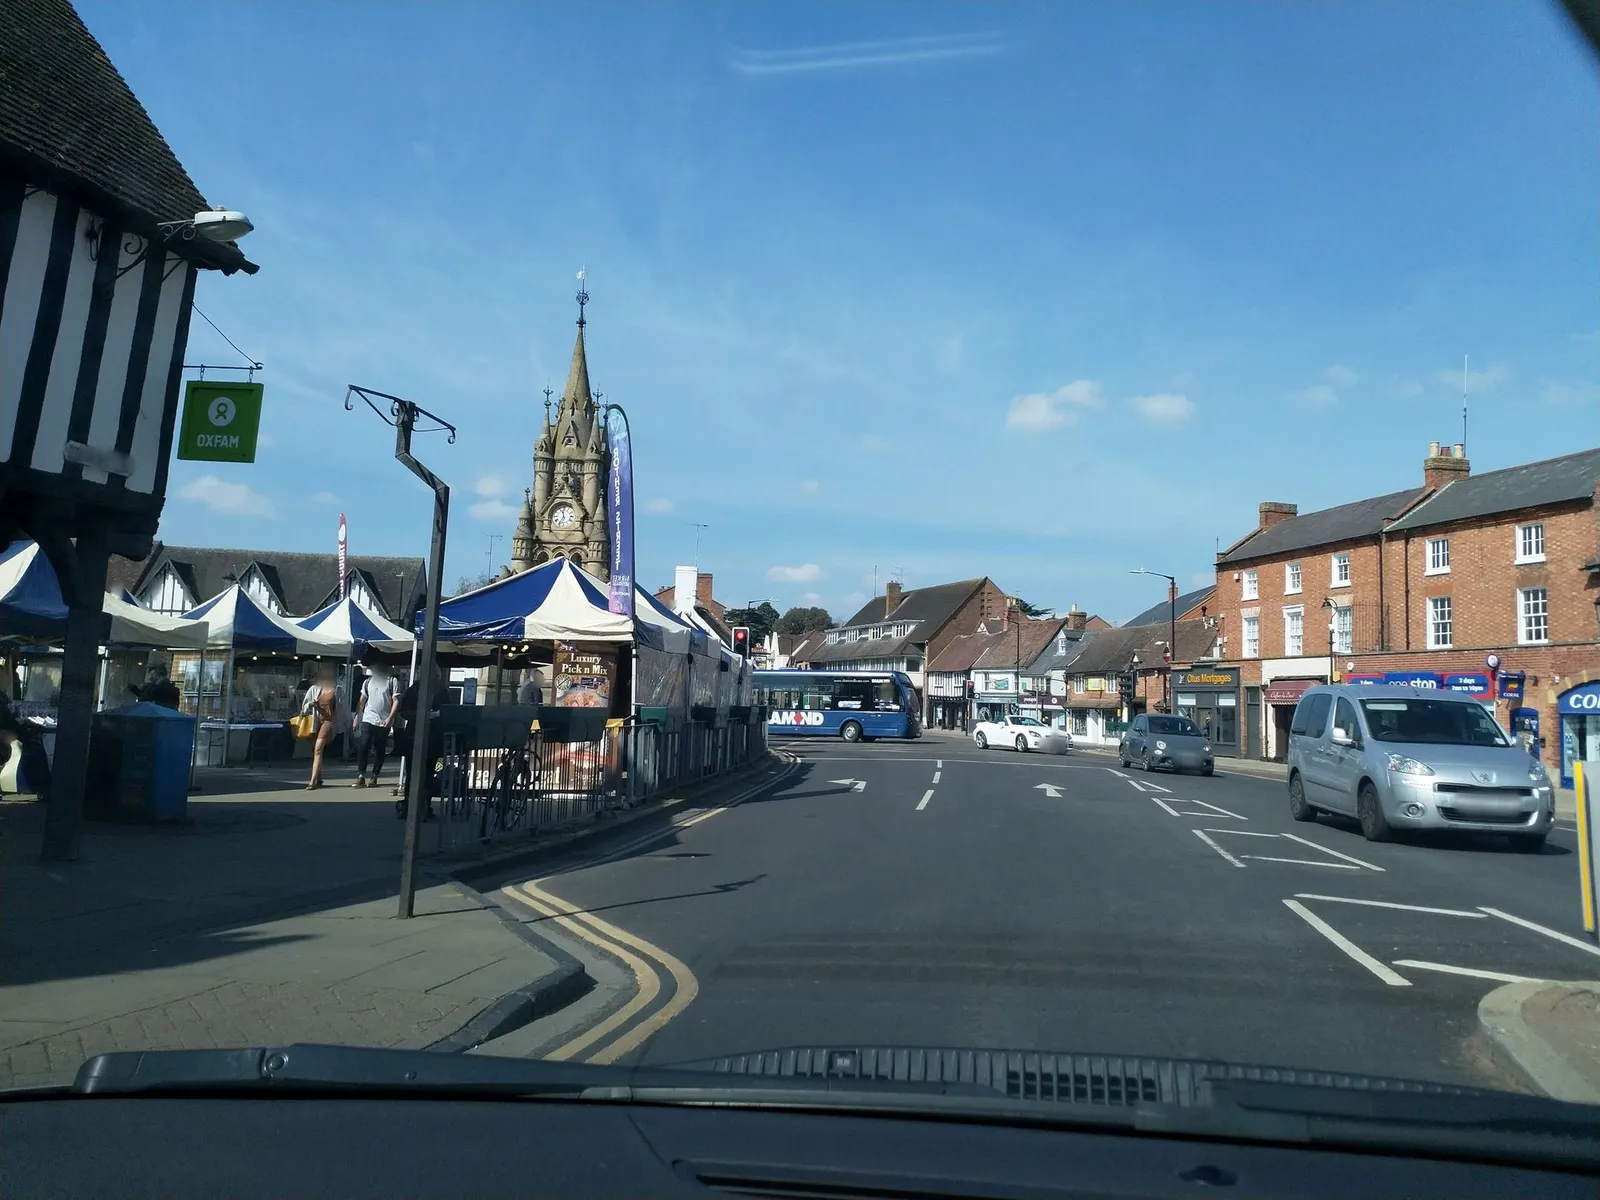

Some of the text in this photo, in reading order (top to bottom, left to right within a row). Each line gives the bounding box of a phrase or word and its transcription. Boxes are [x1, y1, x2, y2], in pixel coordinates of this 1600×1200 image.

[197, 434, 240, 448] OXFAM
[570, 652, 602, 665] Luxury
[561, 663, 582, 674] Pick
[592, 664, 608, 675] Mix
[1201, 673, 1232, 684] Mortgages
[1569, 693, 1600, 709] CO
